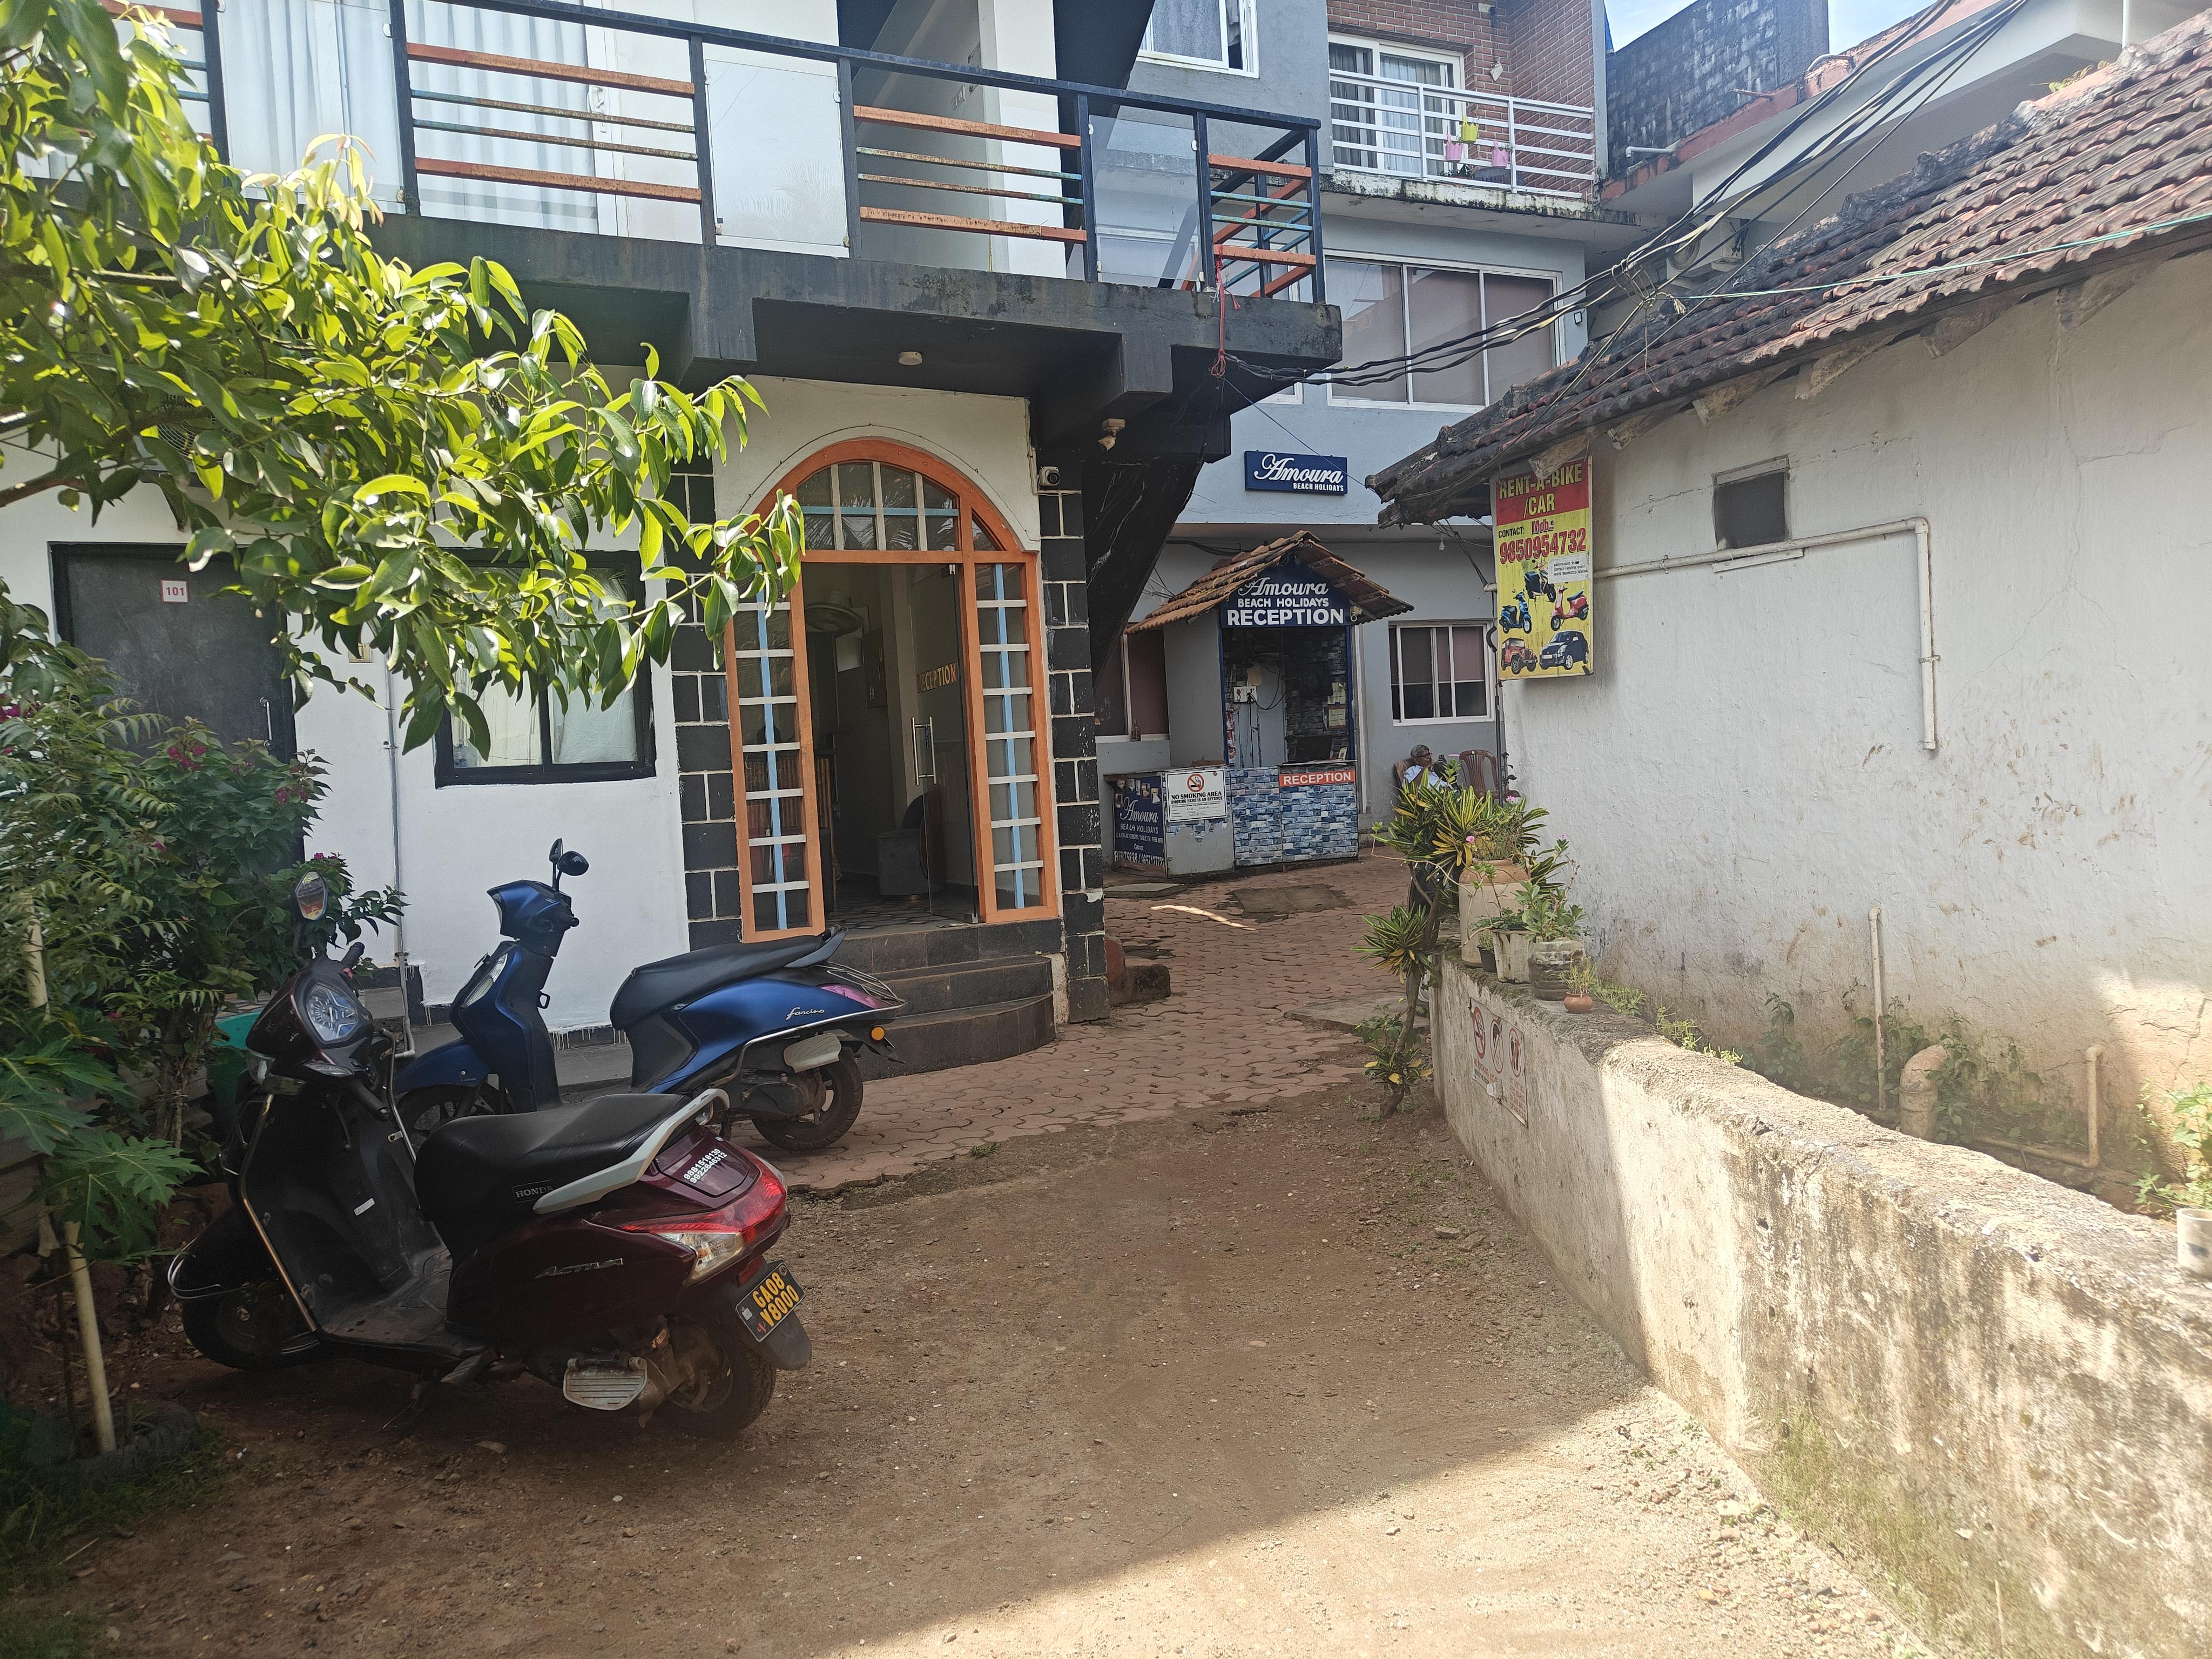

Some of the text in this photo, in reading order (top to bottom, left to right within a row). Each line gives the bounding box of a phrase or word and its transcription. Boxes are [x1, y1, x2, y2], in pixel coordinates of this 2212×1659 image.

[1254, 454, 1344, 483] Amoura
[1314, 483, 1344, 491] HOLIDAYS
[1500, 527, 1587, 564] 9850954732
[166, 587, 184, 596] 101
[1238, 577, 1328, 596] Amoura
[1238, 597, 1329, 608] BEACH HOLIDAYS
[1227, 608, 1344, 626] RECEPTION
[1283, 771, 1351, 786] RECEPTION
[1120, 797, 1158, 823] Amoura
[1120, 823, 1158, 834] BEACH HOLIDAYS
[683, 1149, 721, 1179] 9881518130
[752, 1272, 785, 1309] GA08
[760, 1285, 800, 1327] V8000
